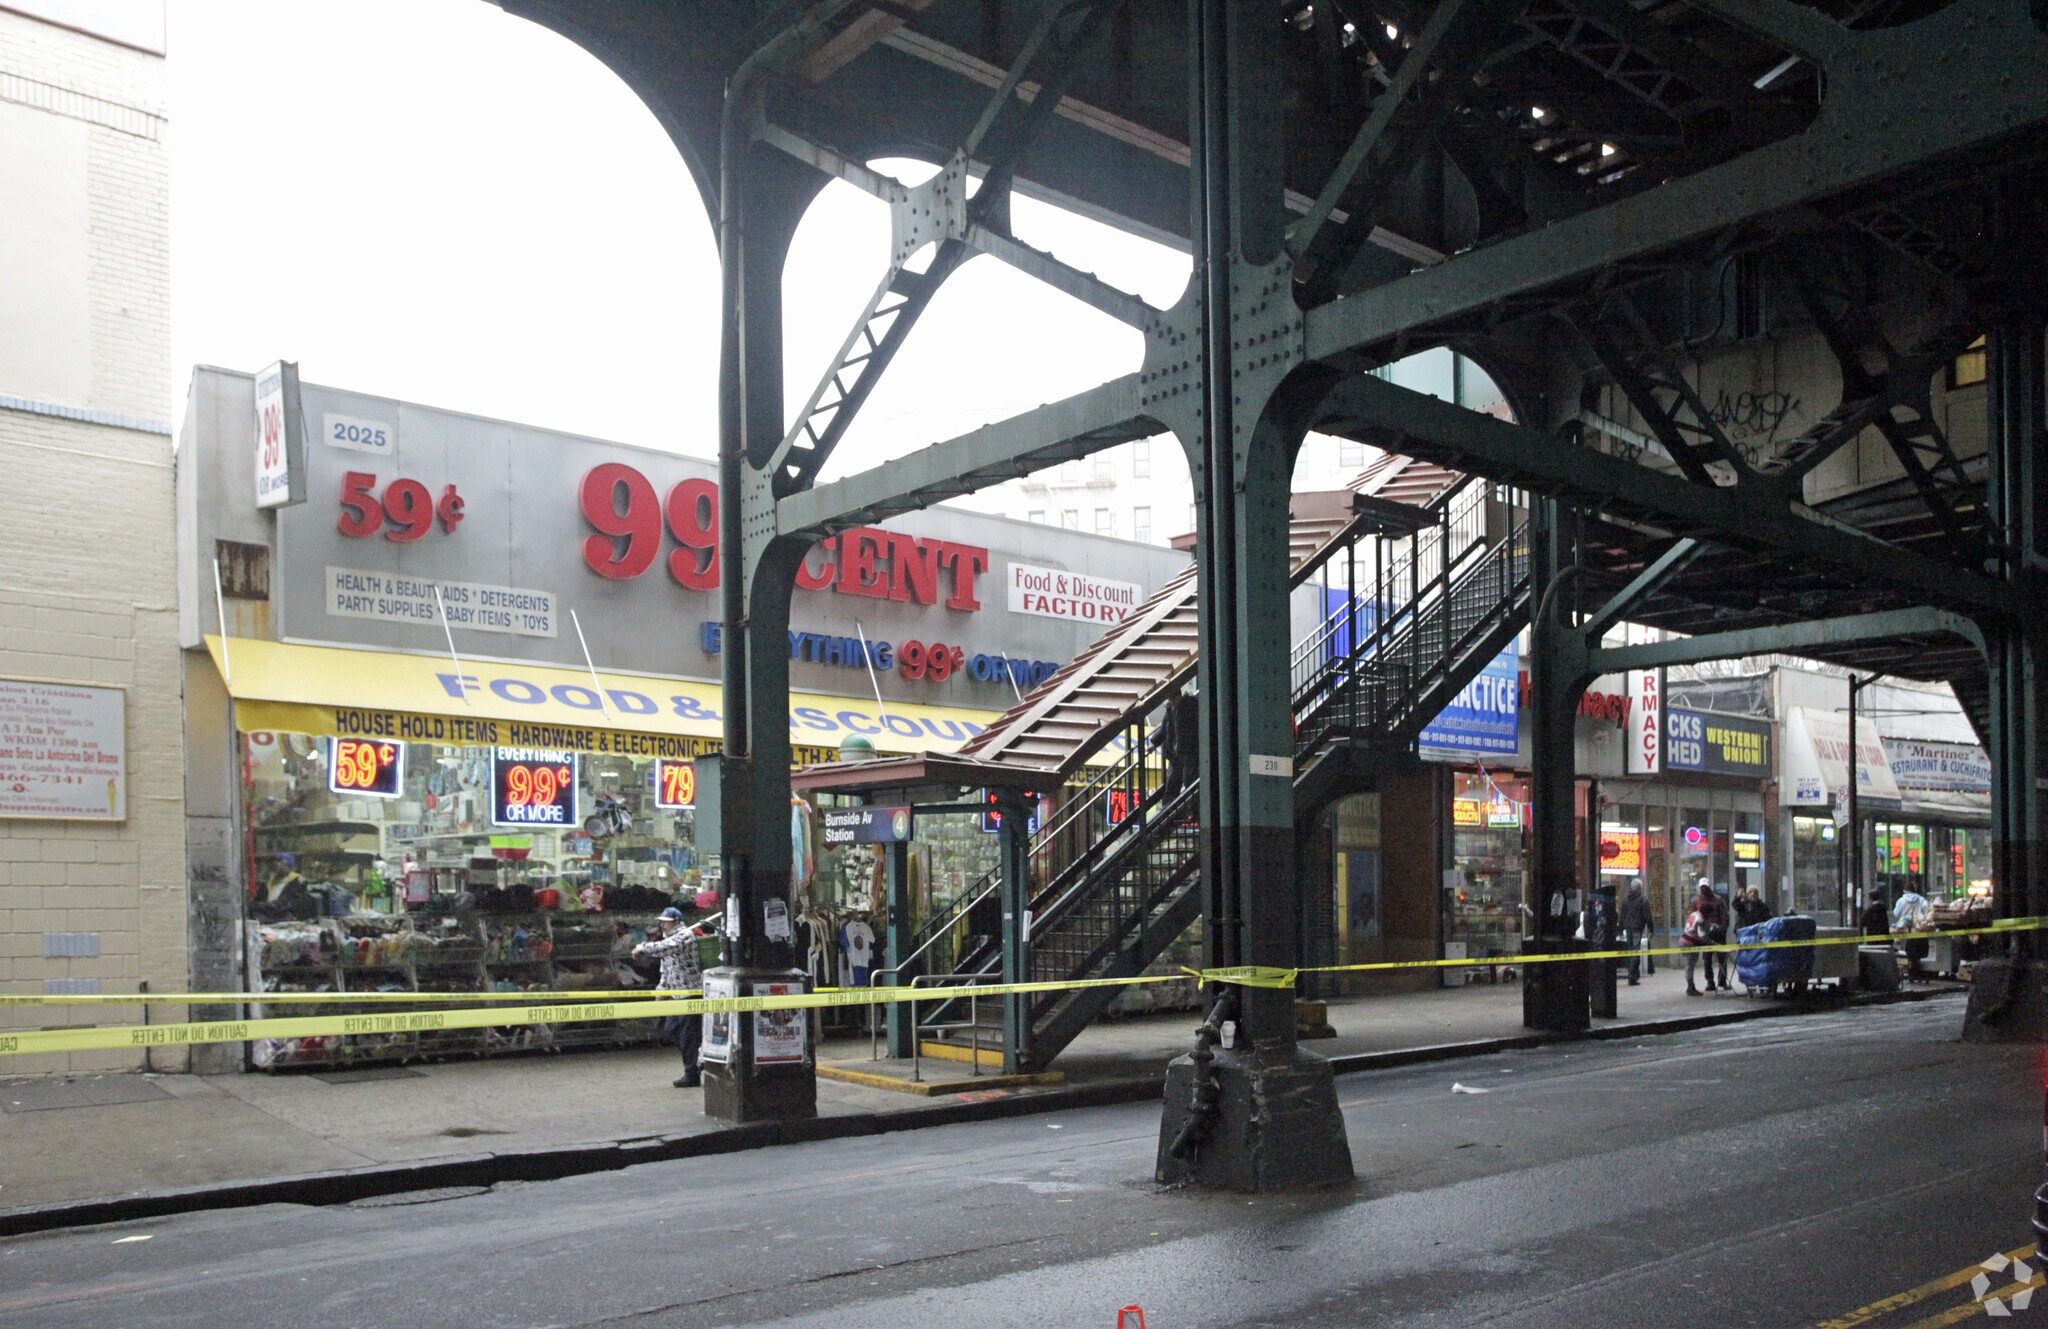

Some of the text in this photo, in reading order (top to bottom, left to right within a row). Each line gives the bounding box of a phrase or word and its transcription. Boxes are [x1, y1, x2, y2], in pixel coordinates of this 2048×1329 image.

[334, 423, 386, 447] 2025
[338, 471, 466, 543] 59¢
[336, 573, 549, 613] HEALTH & BEAUTY AIDS DETERGENTS
[1015, 567, 1134, 605] Food & Discount
[337, 595, 549, 631] PARTY SUPPLIES BABY ITEMS TOYS
[1023, 593, 1127, 622] FACTORY
[701, 622, 893, 671] EYTHING
[900, 639, 965, 682] 99¢
[31, 688, 92, 699] Cristiana
[435, 673, 658, 714] FOOD
[671, 695, 722, 720] &
[4, 735, 98, 749] WKDM 1380 am
[24, 725, 43, 735] Am
[47, 726, 66, 736] Por
[335, 710, 395, 736] HOUSE
[400, 715, 444, 740] HOLD
[450, 721, 498, 744] ITEMS
[510, 724, 593, 750] HARDWARE
[600, 733, 608, 751] &
[614, 733, 700, 758] ELECTRONIC
[826, 750, 836, 763] &
[1706, 727, 1759, 749] WESTERN
[337, 742, 395, 787] 59¢
[1265, 760, 1278, 770] 230
[1723, 746, 1758, 765] UNION
[1907, 746, 1975, 760] "Martinez"
[1891, 759, 1938, 774] ESTAURANT
[1941, 760, 1948, 772] &
[508, 765, 571, 806] 99¢
[663, 765, 695, 805] 79
[507, 805, 563, 821] OR MORE
[825, 811, 904, 832] Burnside Av 4
[826, 829, 854, 842] Station
